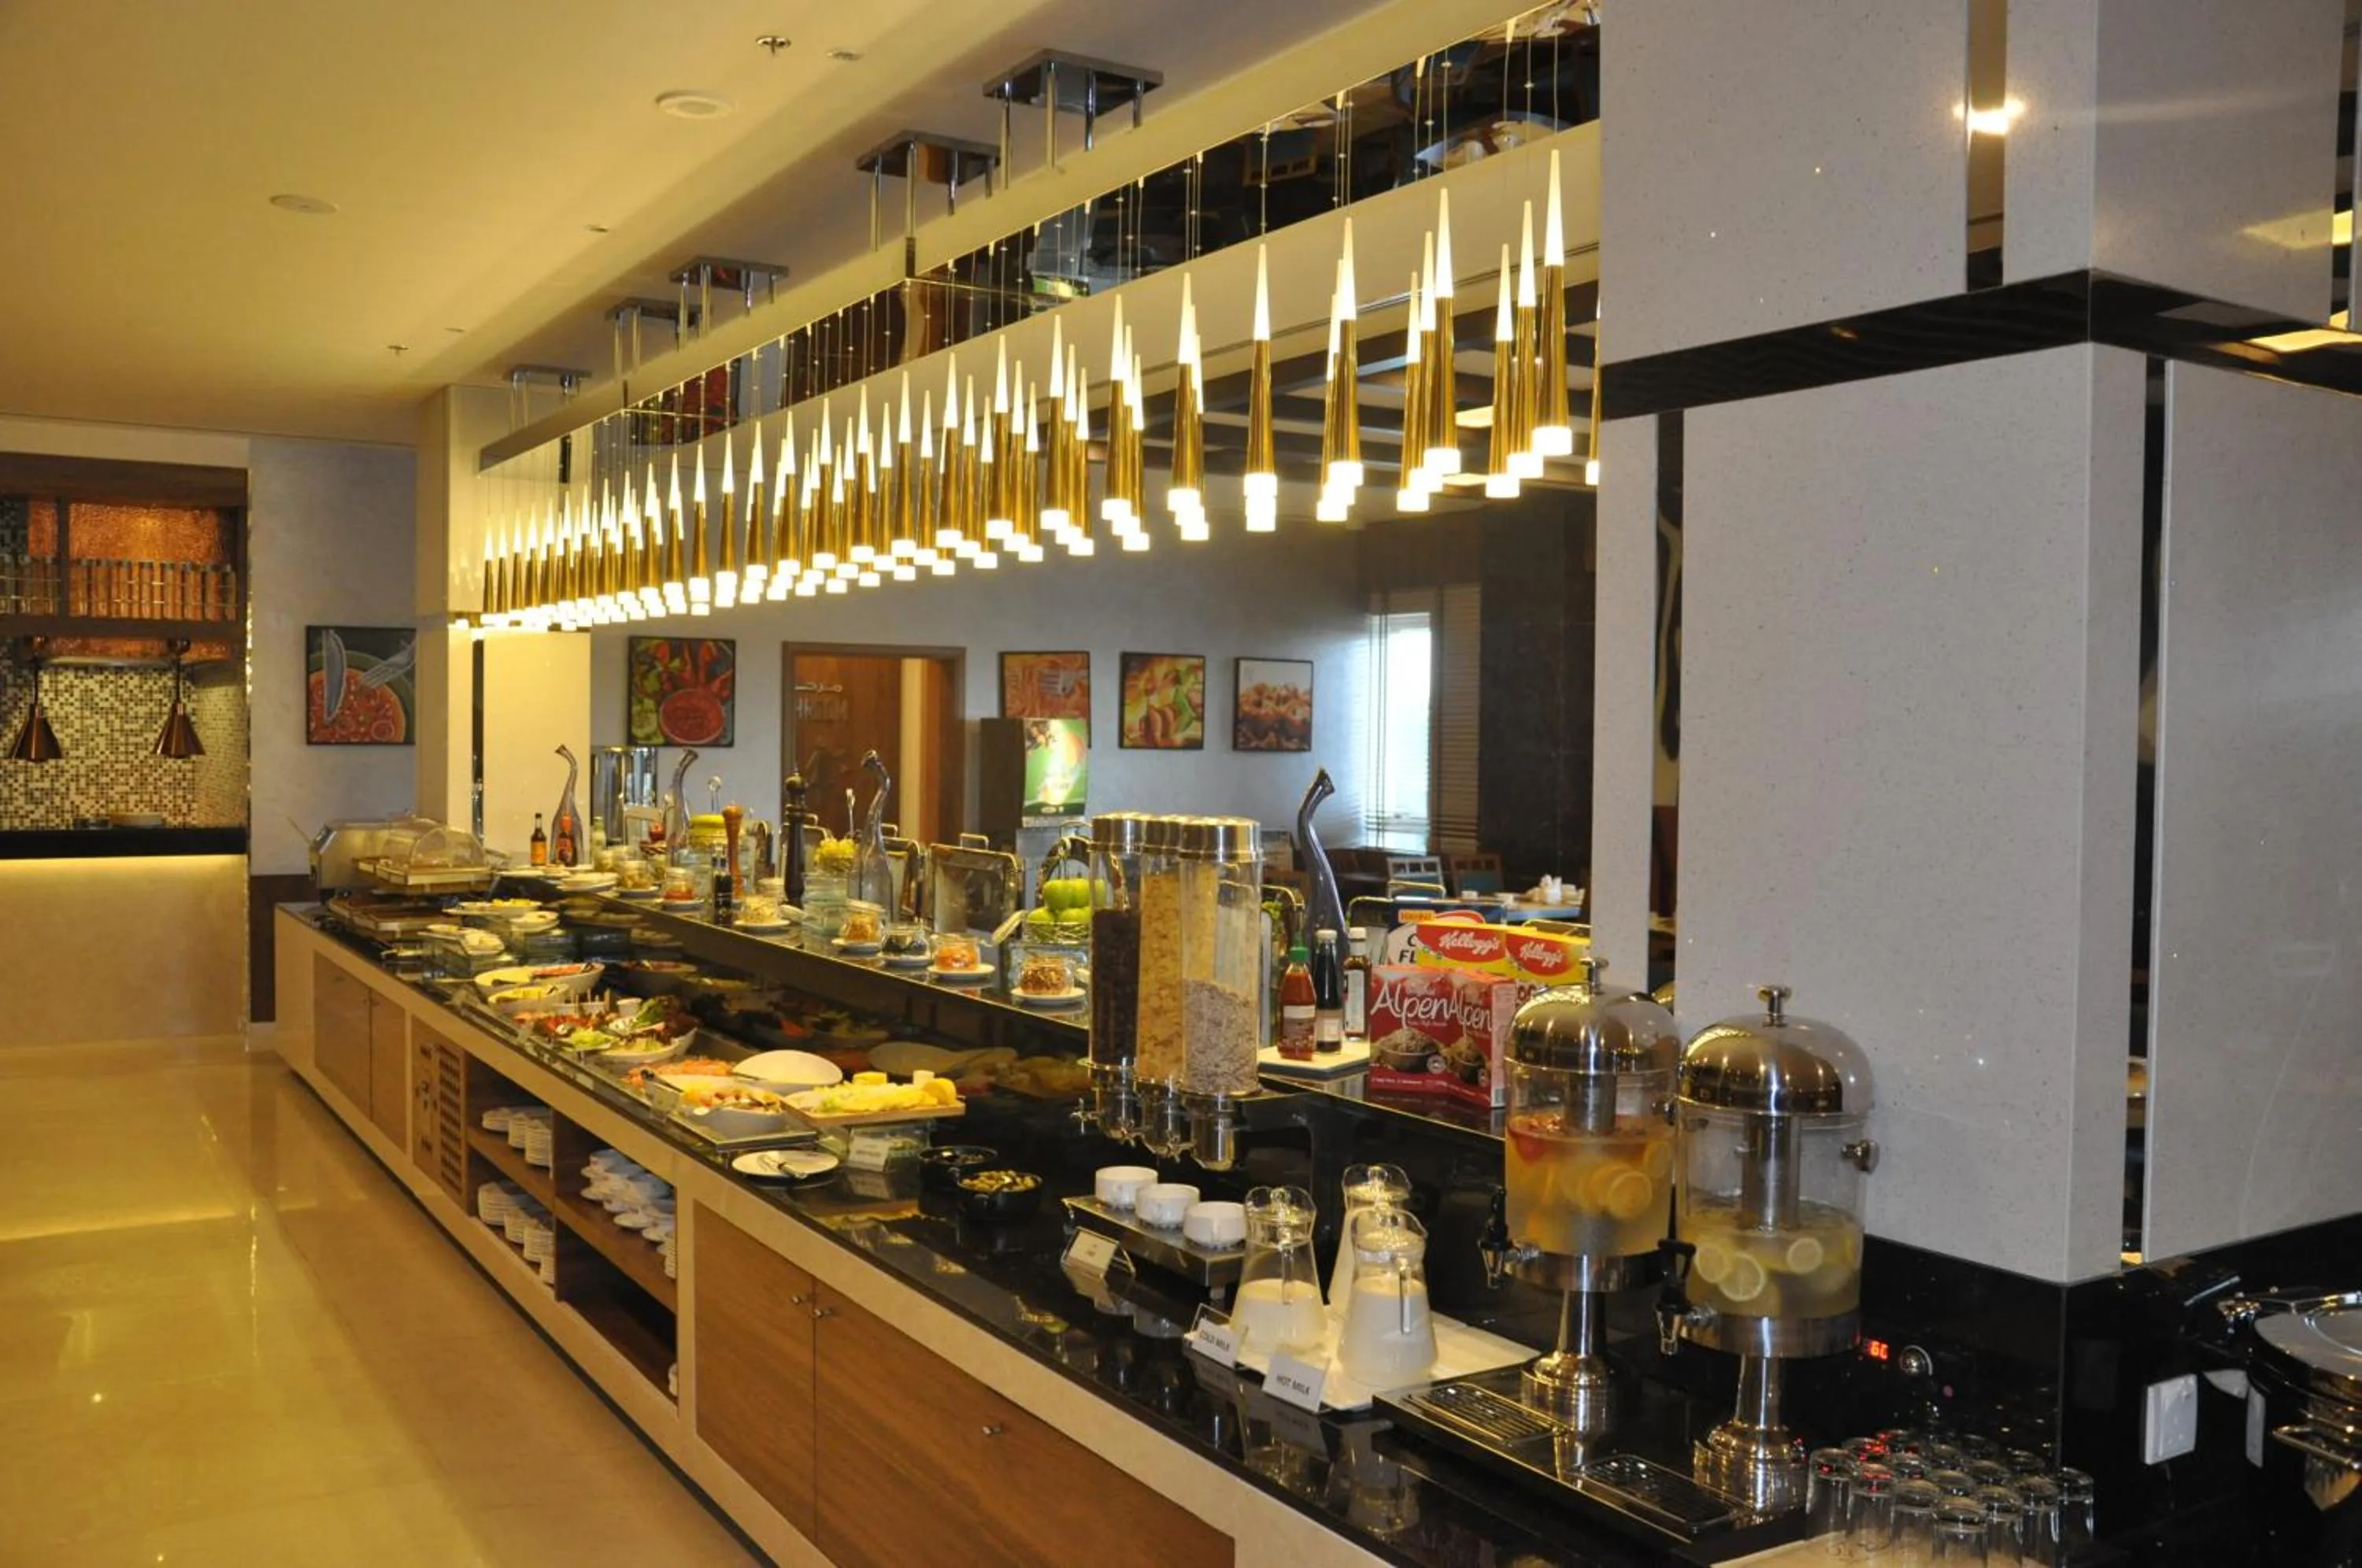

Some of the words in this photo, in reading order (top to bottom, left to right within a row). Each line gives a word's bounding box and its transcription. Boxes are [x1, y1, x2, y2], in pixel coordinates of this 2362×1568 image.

[1439, 930, 1501, 956] Kellogg's
[1520, 941, 1563, 968] Kellogg's
[1370, 982, 1449, 1029] Alpen
[1449, 988, 1493, 1037] Alpen
[1216, 1337, 1230, 1352] MILK
[1276, 1374, 1292, 1388] HOT
[1292, 1379, 1310, 1396] MILK
